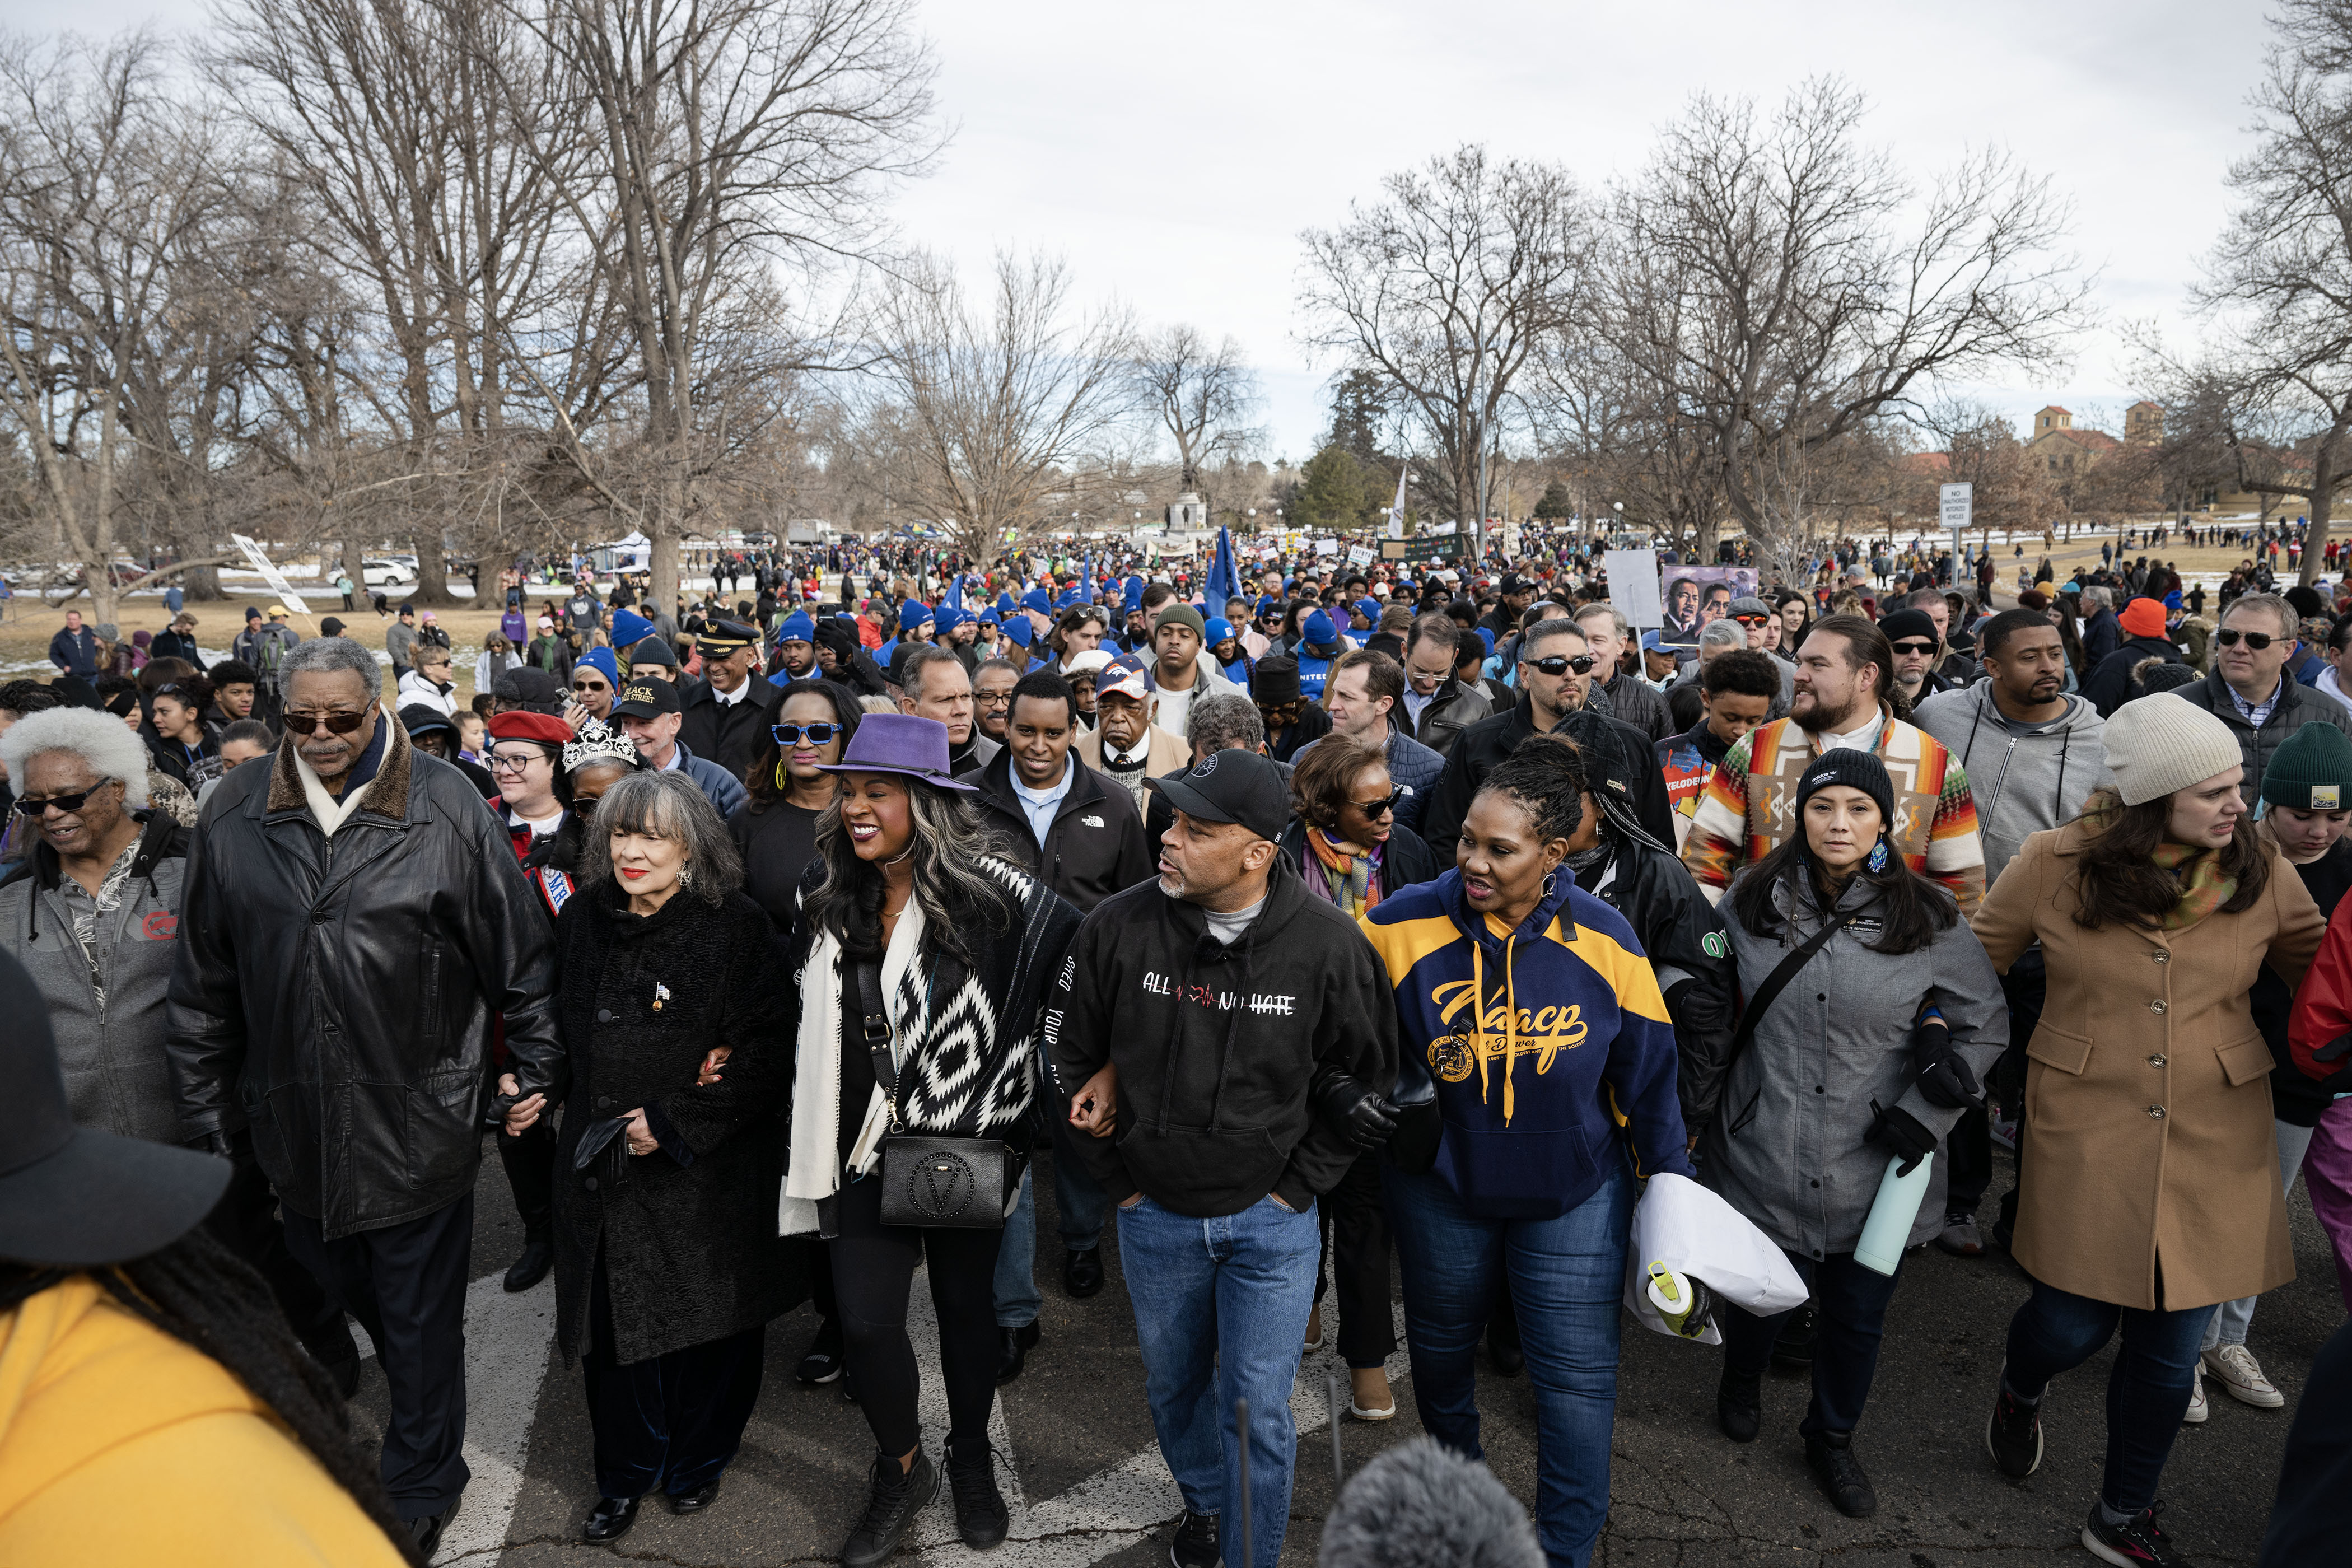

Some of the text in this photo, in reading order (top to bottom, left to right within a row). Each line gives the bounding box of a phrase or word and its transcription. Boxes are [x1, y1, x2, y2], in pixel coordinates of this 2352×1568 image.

[624, 686, 653, 696] BLACK
[631, 694, 655, 703] STREET
[1812, 772, 1829, 782] adidas
[1058, 955, 1075, 992] SHED
[1142, 972, 1296, 1015] ALL NO HATE
[1044, 1009, 1064, 1044] YOUR
[1567, 1039, 1586, 1049] BOLDEST
[805, 1354, 830, 1363] PUMA
